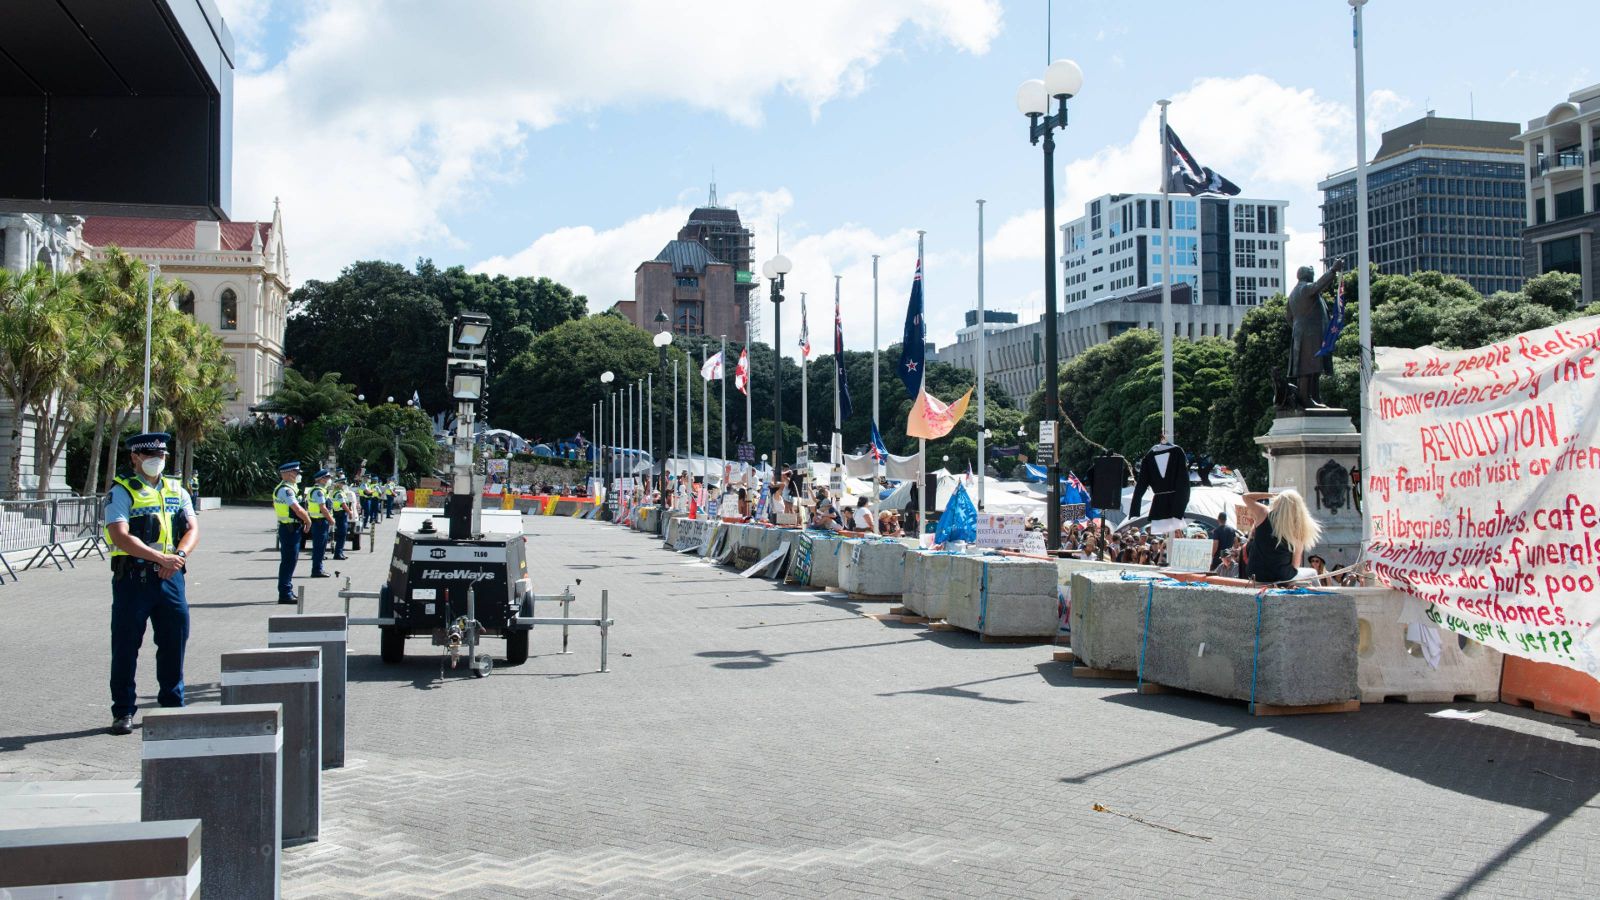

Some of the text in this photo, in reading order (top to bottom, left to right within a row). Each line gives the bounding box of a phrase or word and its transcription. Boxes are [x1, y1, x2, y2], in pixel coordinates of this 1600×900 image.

[1402, 328, 1600, 382] To the people feelin
[1379, 366, 1519, 420] inconvenienced
[1518, 366, 1542, 400] by
[1370, 474, 1390, 503] my
[1396, 464, 1445, 500] family
[1486, 456, 1521, 483] visit
[1529, 457, 1551, 476] or
[1555, 443, 1600, 472] atten
[1533, 493, 1600, 531] cafe
[422, 569, 495, 581] HireWays
[1380, 538, 1447, 576] birthing
[1458, 568, 1489, 590] doc
[1425, 603, 1443, 624] do
[1446, 613, 1471, 633] you
[1495, 623, 1511, 644] it
[1515, 630, 1576, 661] yet??
